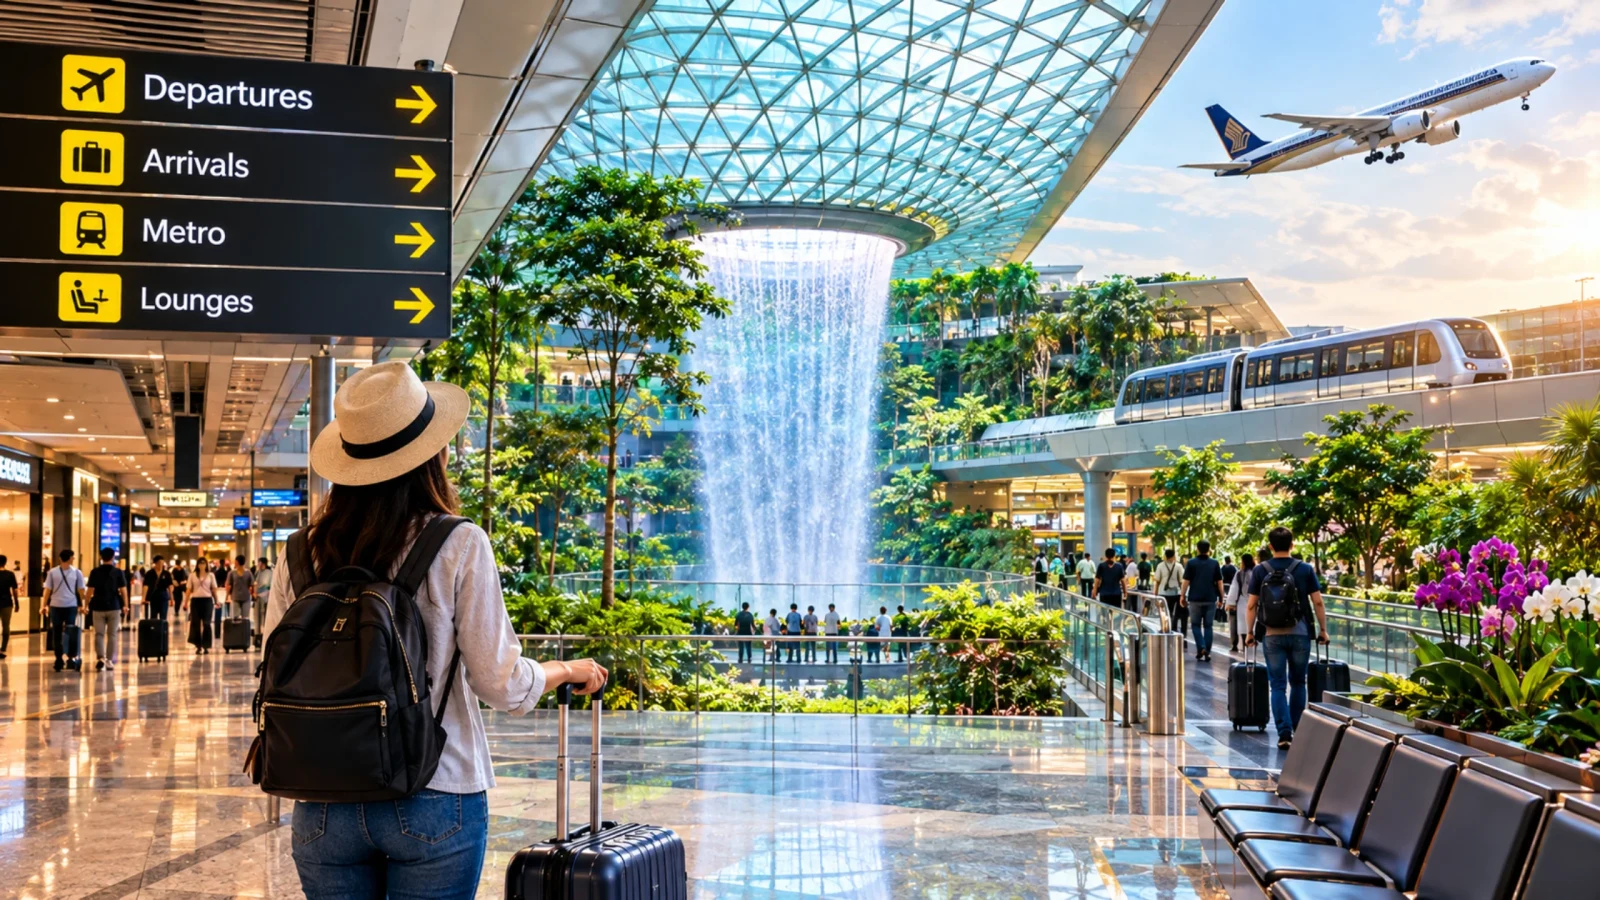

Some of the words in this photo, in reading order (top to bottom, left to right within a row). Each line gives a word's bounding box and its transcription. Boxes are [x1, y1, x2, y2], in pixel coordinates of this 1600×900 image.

[143, 73, 313, 110] Departures
[142, 148, 250, 178] Arrivals
[142, 217, 226, 246] Metro
[141, 286, 254, 318] Lounges
